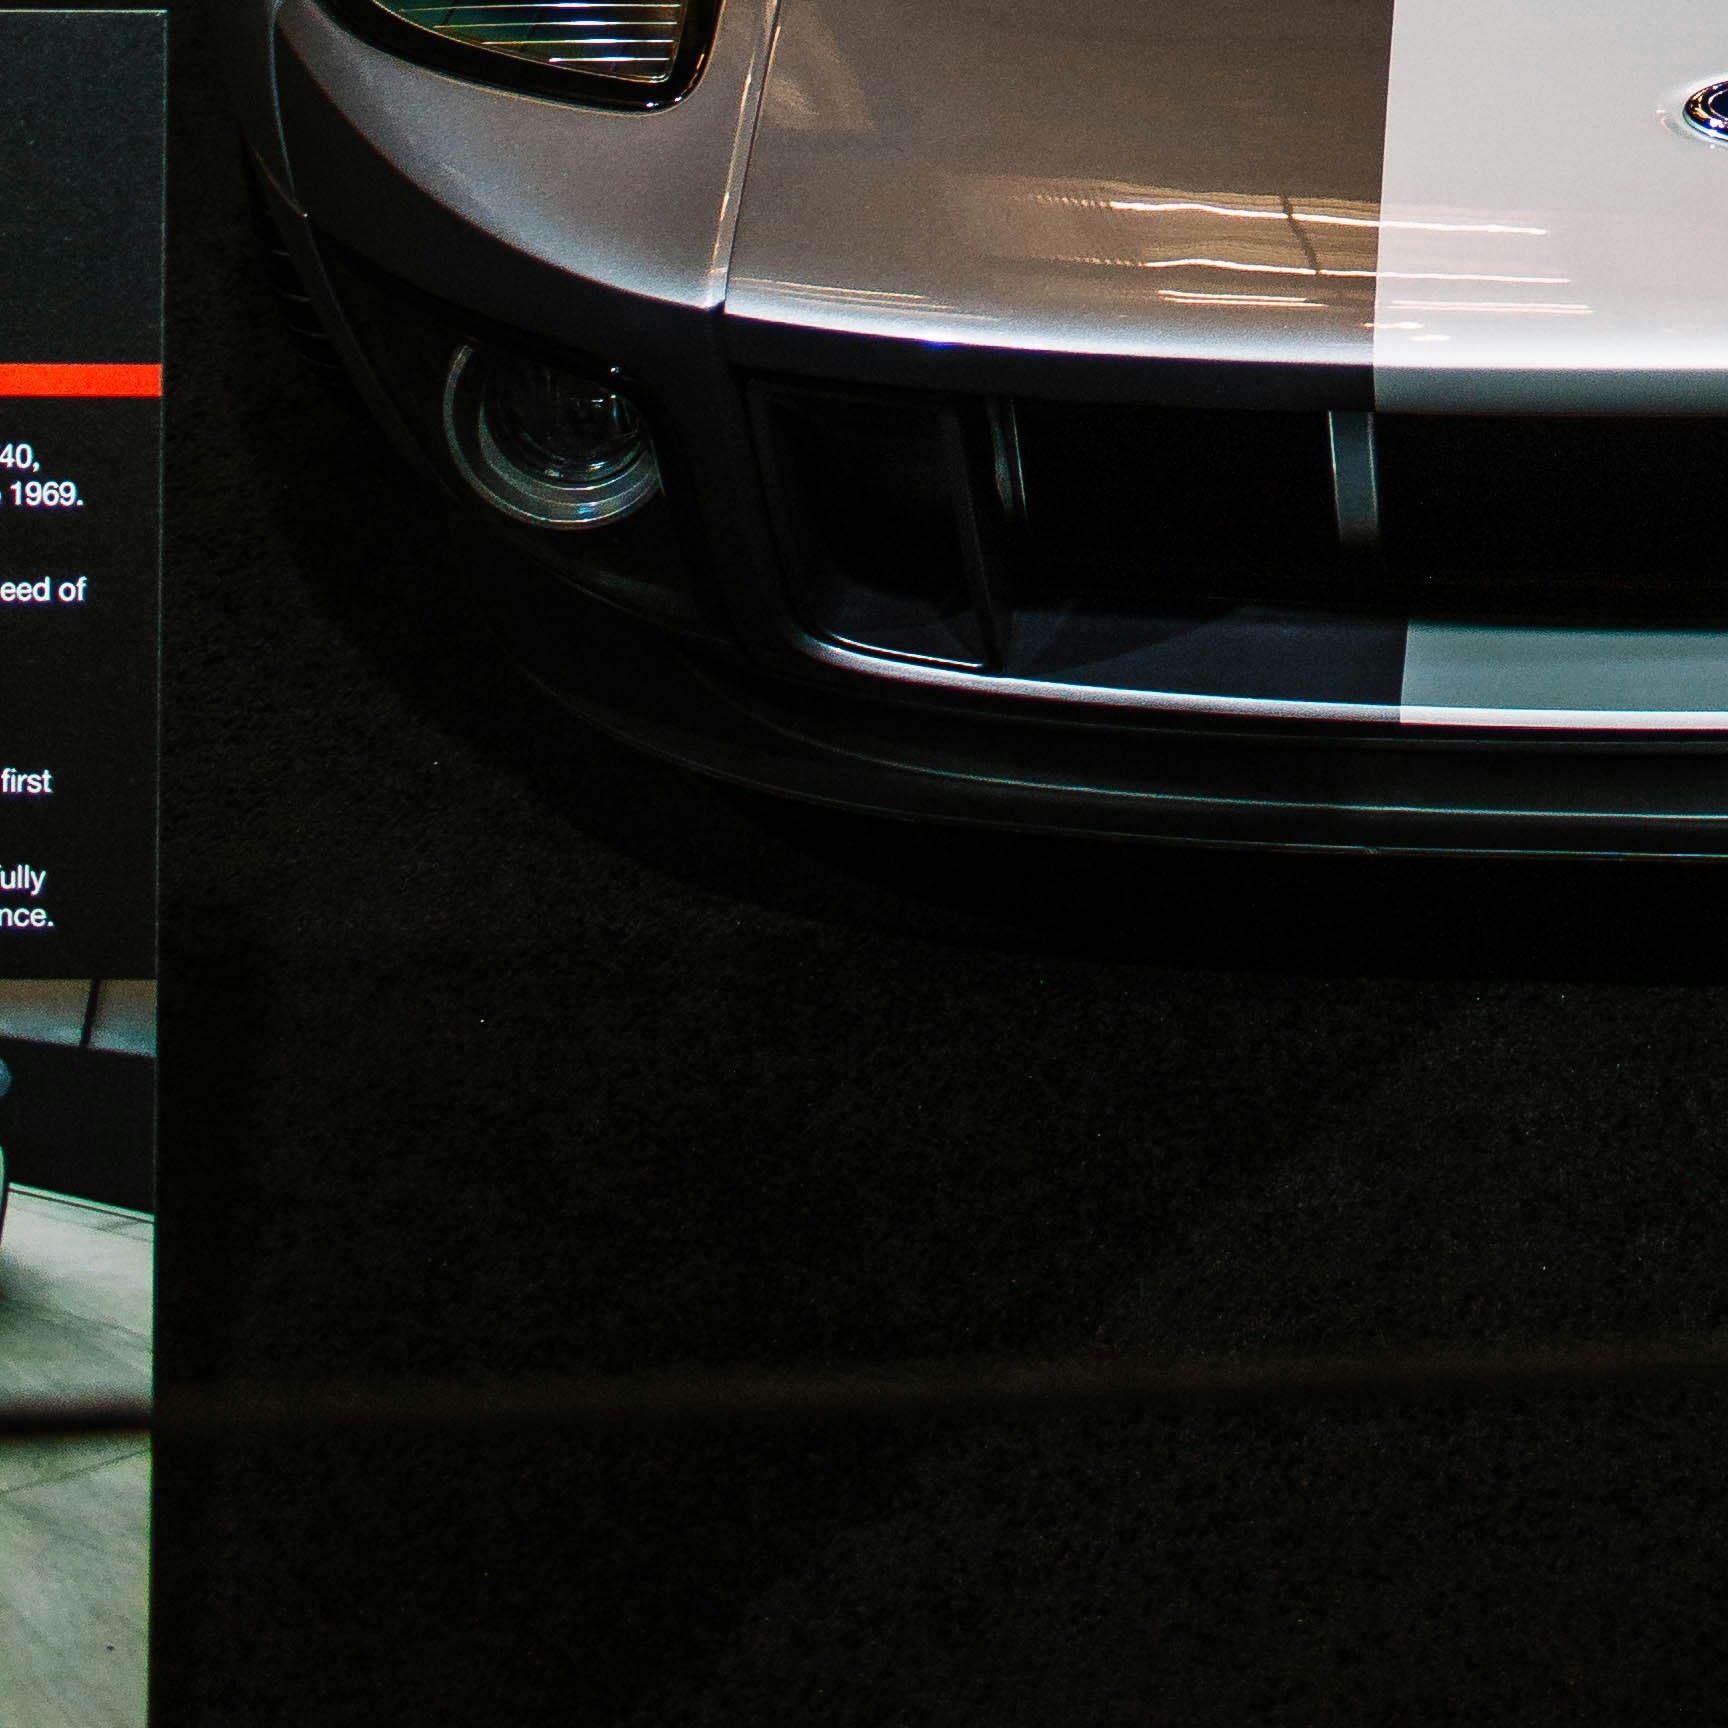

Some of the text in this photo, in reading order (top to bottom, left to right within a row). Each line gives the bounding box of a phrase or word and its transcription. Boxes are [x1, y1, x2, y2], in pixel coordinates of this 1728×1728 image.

[10, 480, 85, 507] 1969.
[0, 575, 88, 602] eed of
[1, 767, 54, 794] first
